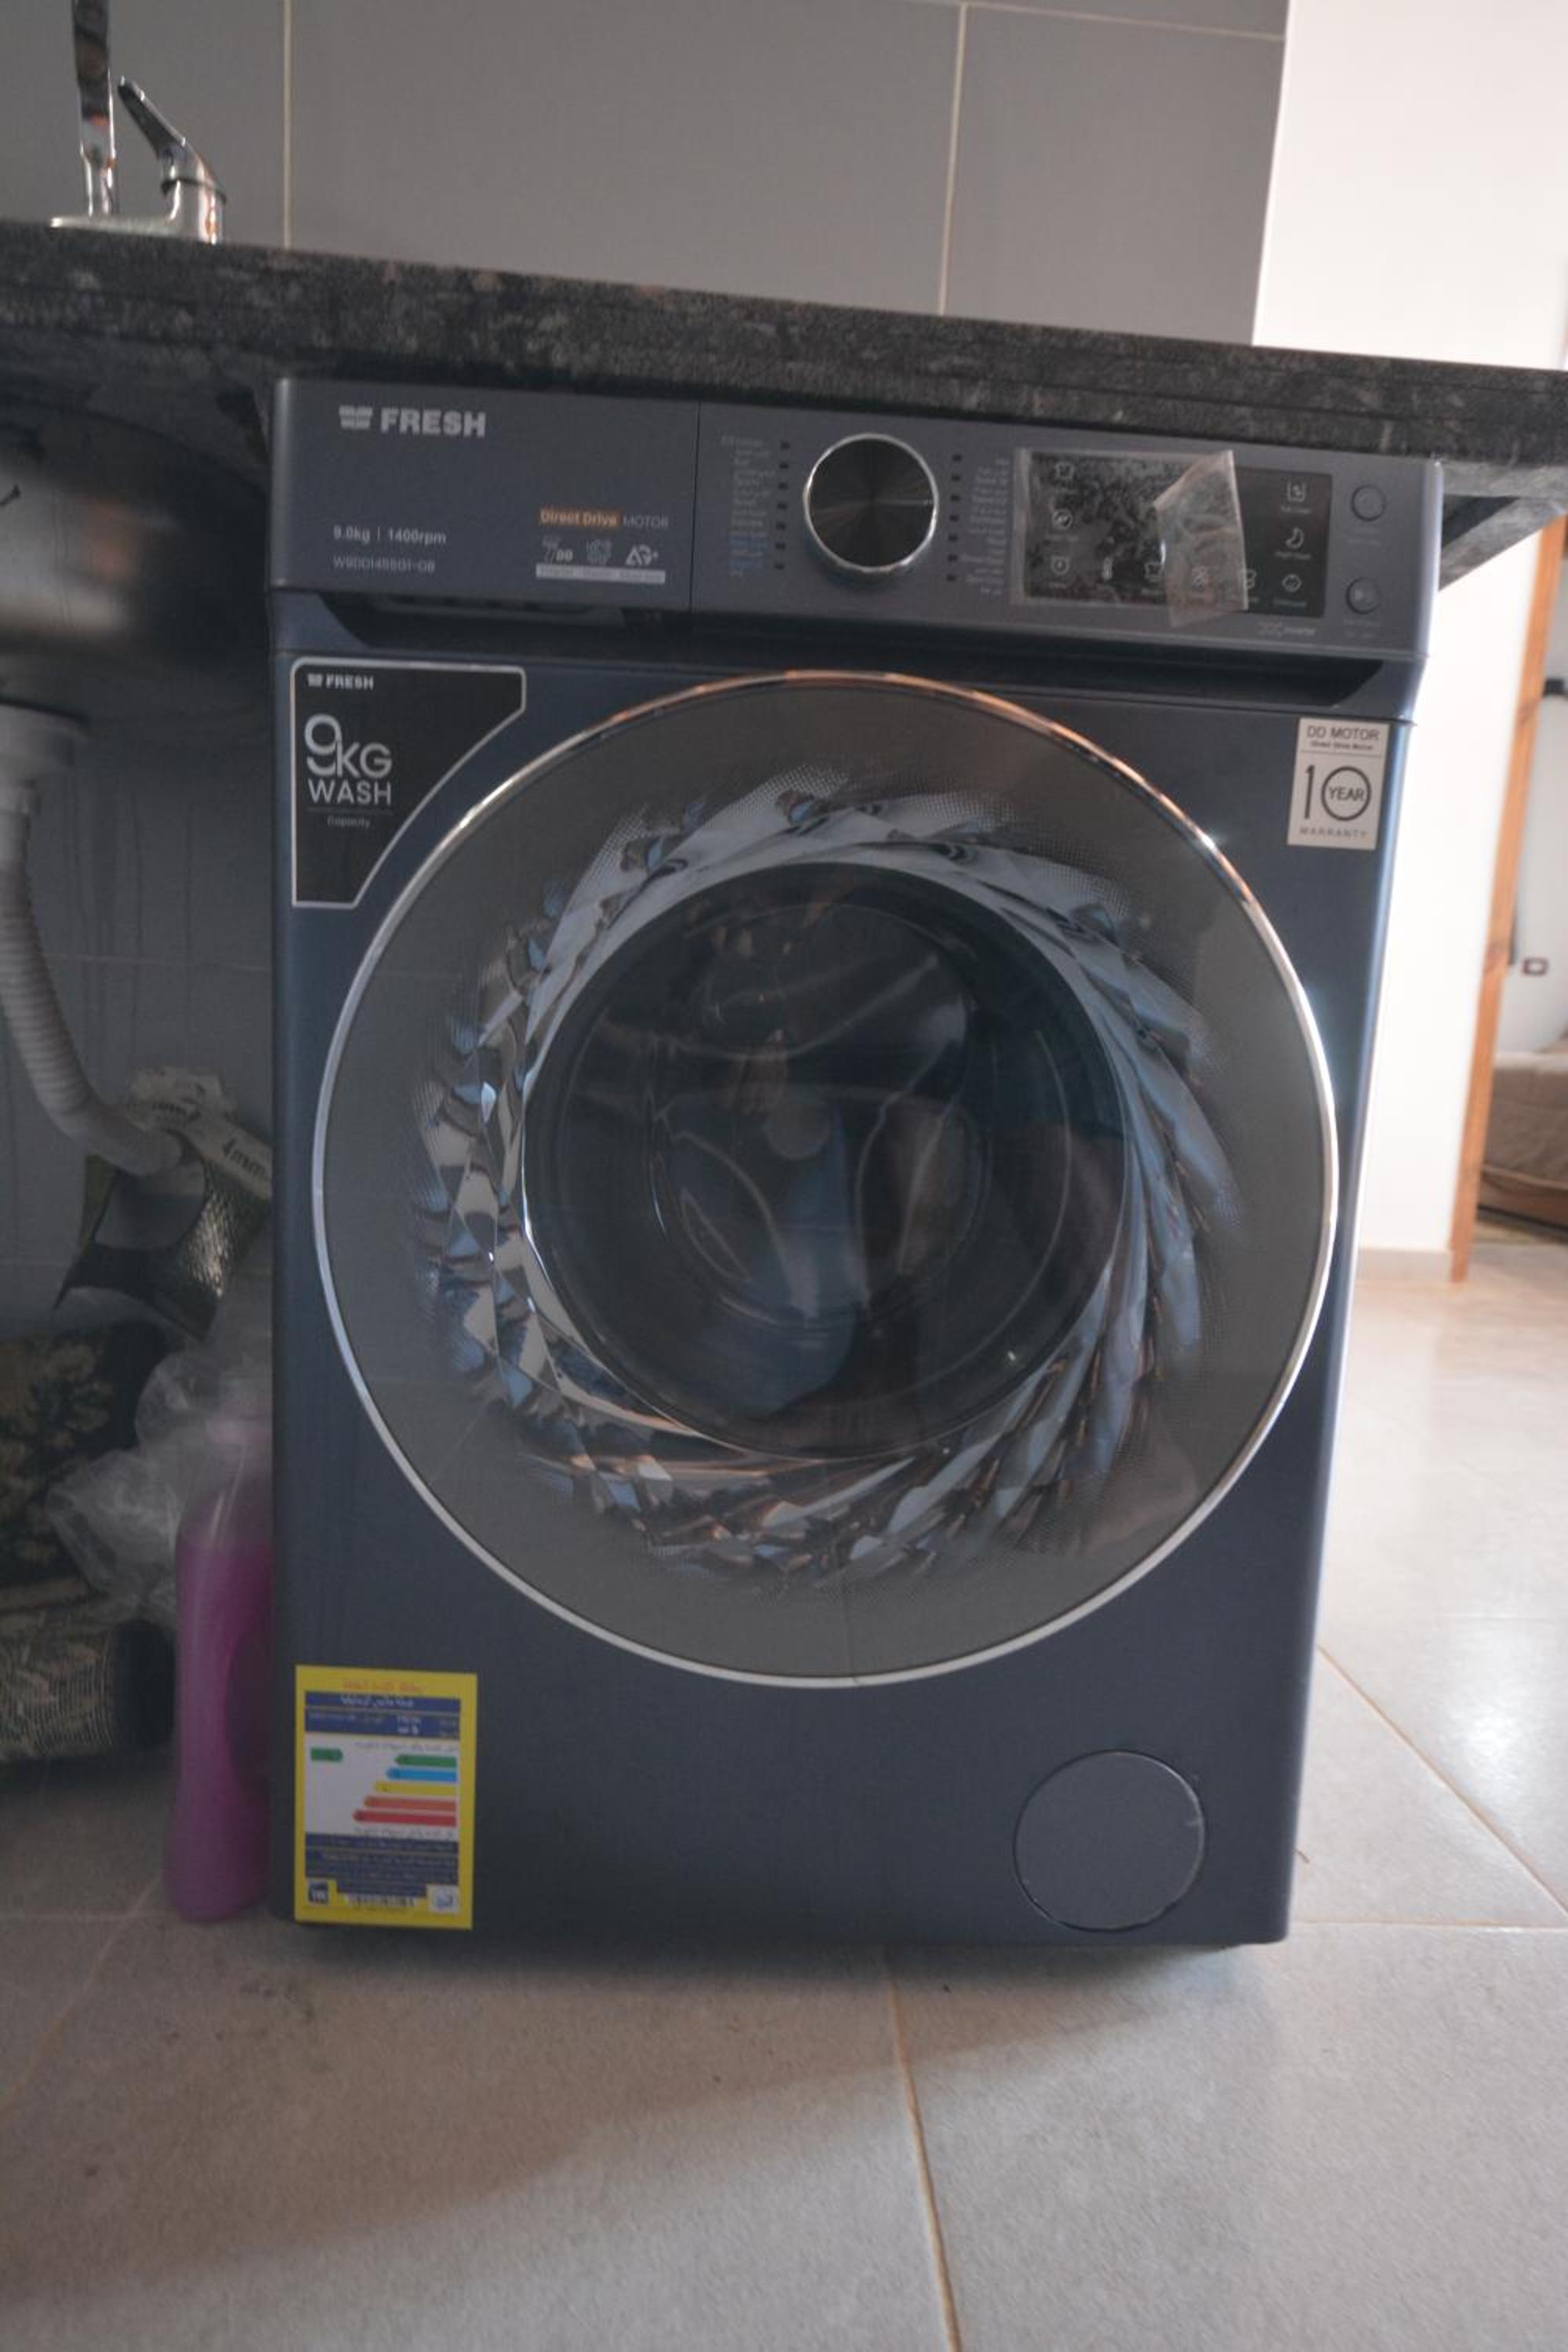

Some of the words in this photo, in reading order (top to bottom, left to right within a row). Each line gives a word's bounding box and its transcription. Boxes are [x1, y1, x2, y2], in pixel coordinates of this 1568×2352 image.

[380, 406, 487, 438] FRESH
[539, 509, 579, 526] Direct
[582, 510, 618, 528] Drive
[622, 514, 669, 528] MOTOR
[387, 527, 448, 546] 1400rpm
[325, 673, 375, 691] FRESH
[1306, 725, 1327, 739] DD
[1330, 727, 1381, 741] MOTOR
[307, 779, 392, 806] WASH
[1304, 764, 1372, 822] 10
[1328, 786, 1366, 801] YEAR
[1298, 826, 1368, 838] WARRANTY
